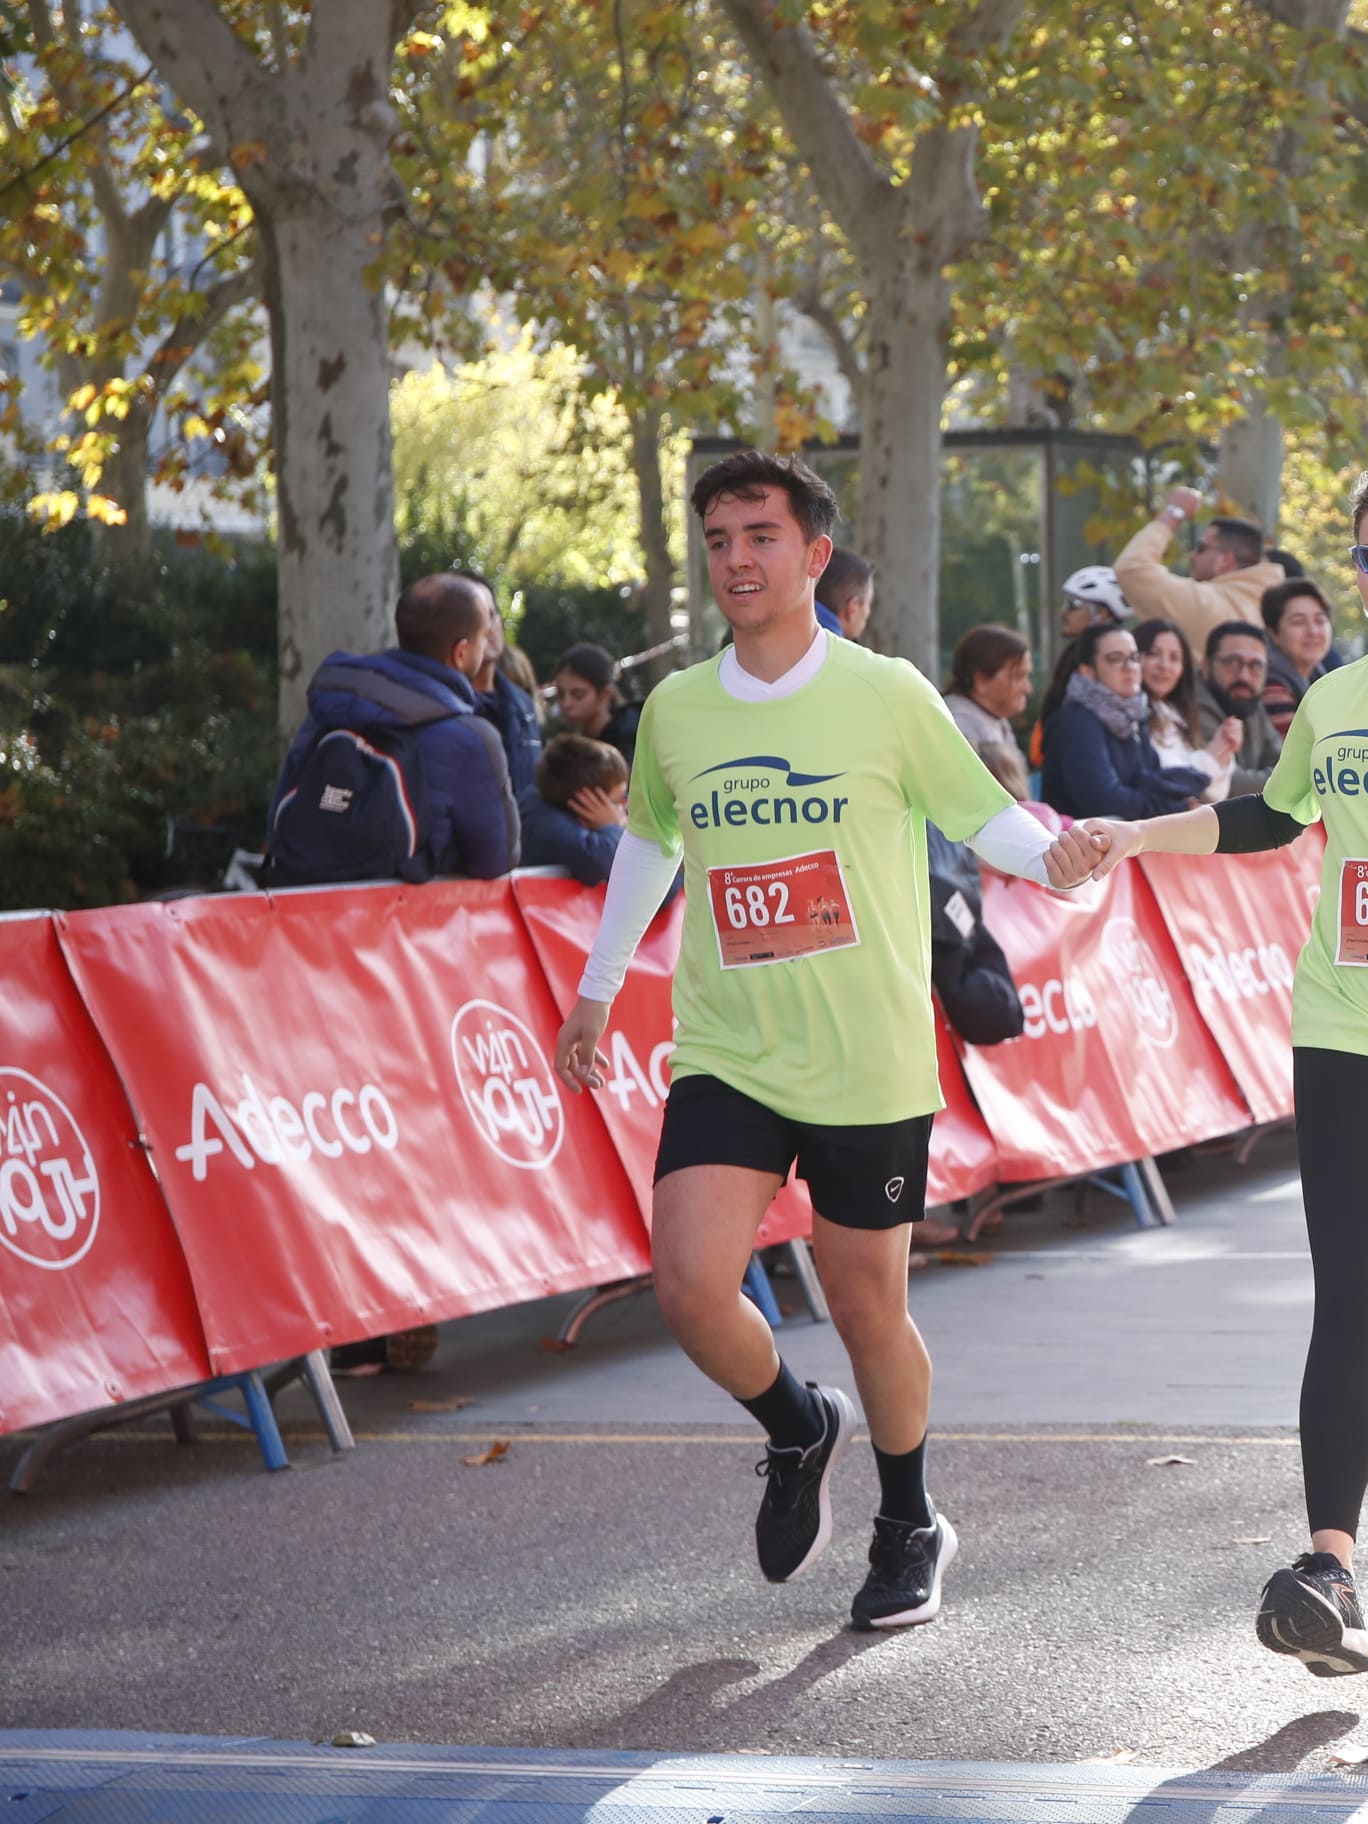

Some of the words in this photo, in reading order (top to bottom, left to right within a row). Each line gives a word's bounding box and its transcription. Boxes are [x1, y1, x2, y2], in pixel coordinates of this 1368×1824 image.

[690, 790, 849, 830] elecnor
[723, 778, 770, 794] grupo
[753, 873, 762, 882] de
[761, 869, 793, 882] empresas
[794, 862, 819, 874] Adecco
[725, 881, 796, 929] 682
[0, 1090, 60, 1167] in
[175, 1072, 399, 1181] Adecco
[469, 1075, 560, 1147] YOUTH
